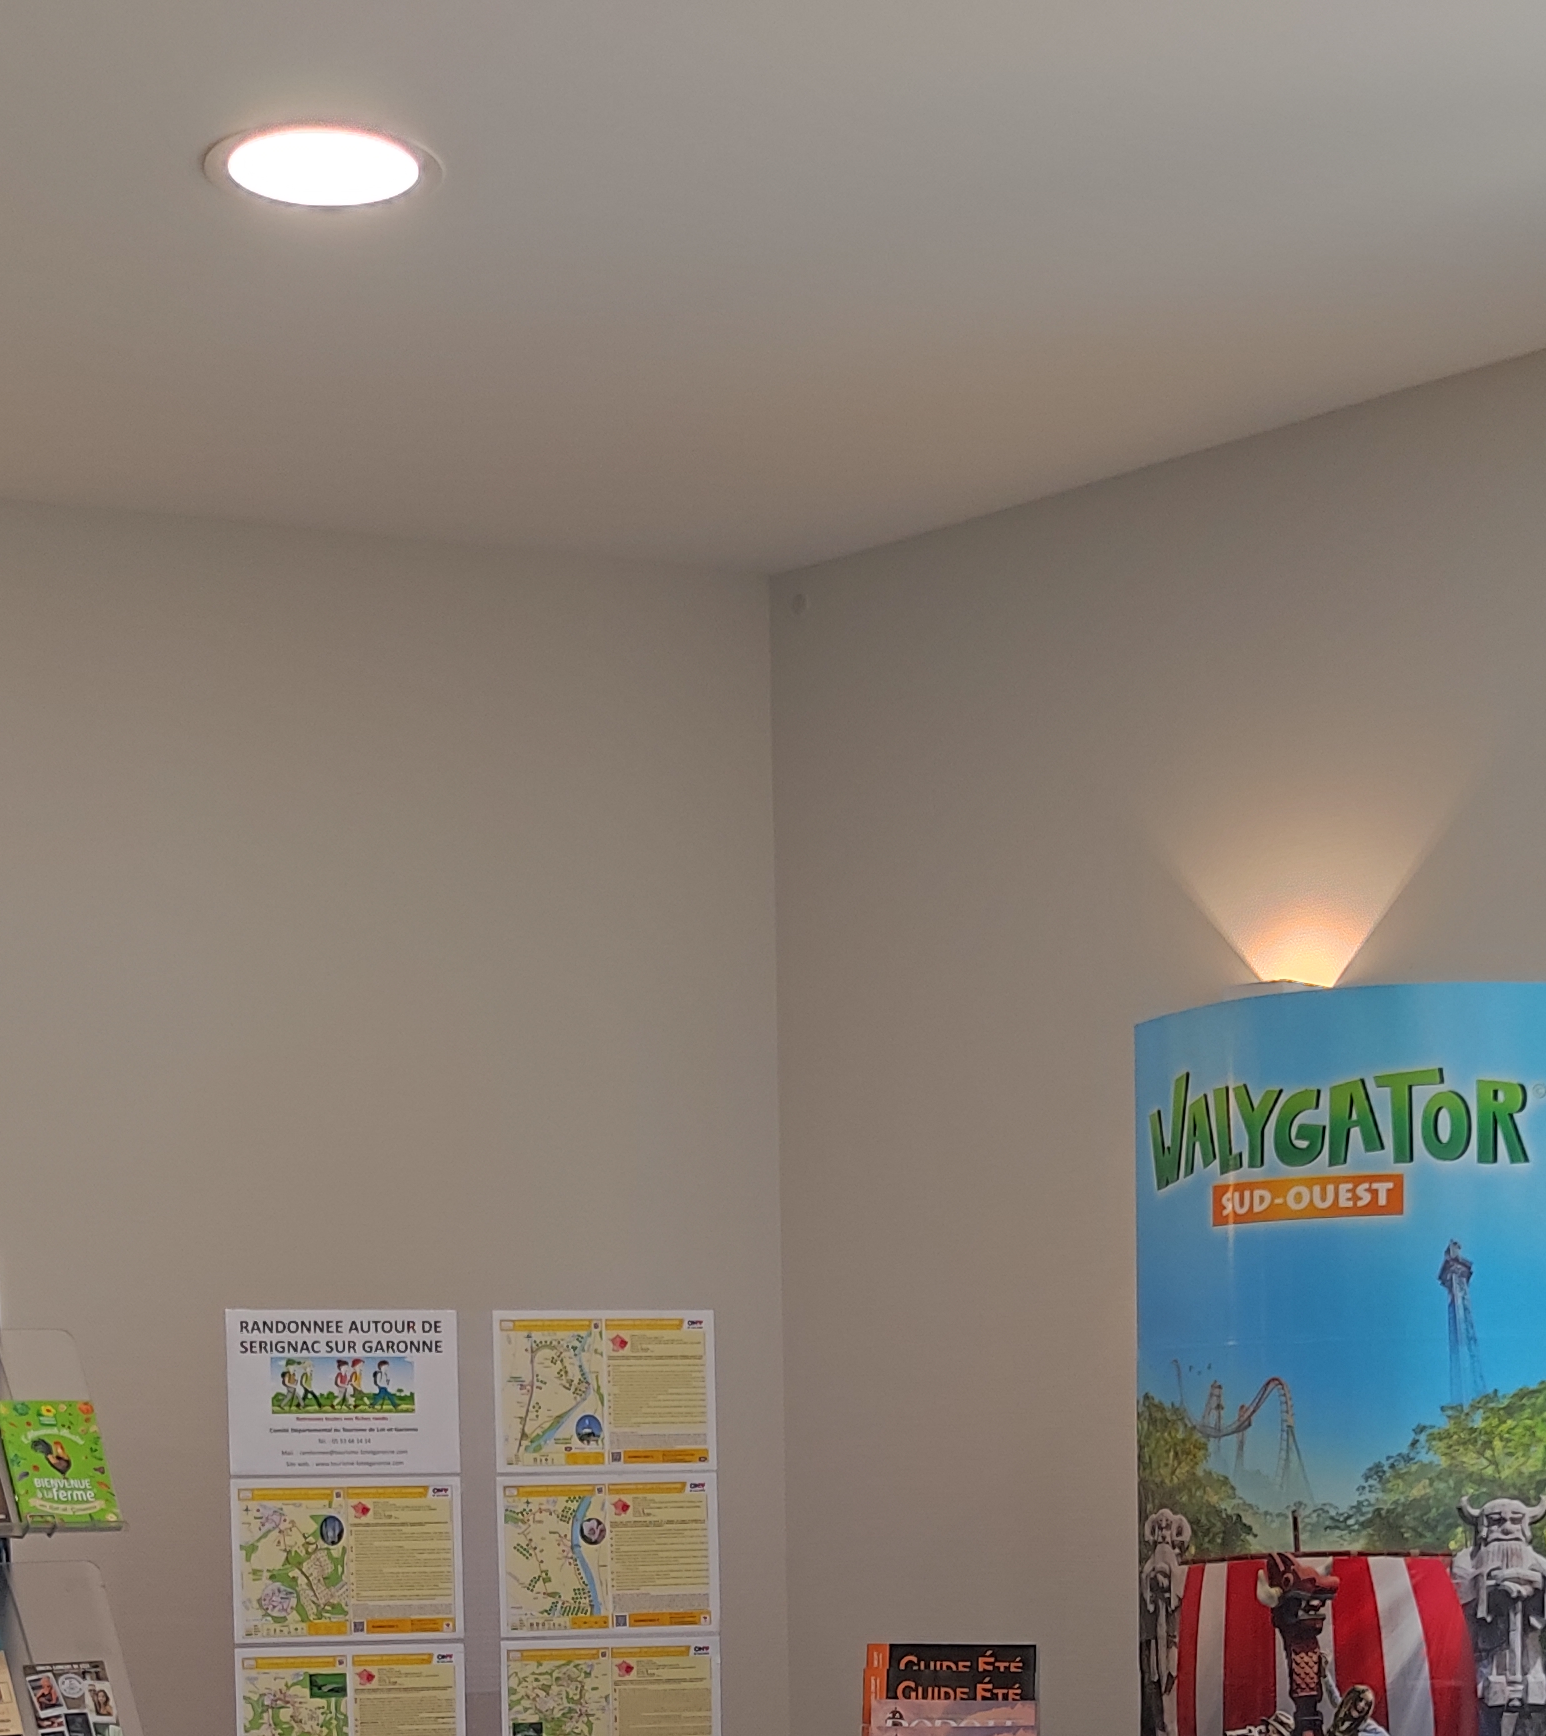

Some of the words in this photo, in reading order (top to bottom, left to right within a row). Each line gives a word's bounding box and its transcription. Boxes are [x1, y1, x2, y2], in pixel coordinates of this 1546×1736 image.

[1149, 1067, 1531, 1191] WALYGATOR
[1220, 1182, 1394, 1217] SUD-OUEST
[239, 1320, 343, 1334] RANDONNEE
[348, 1320, 416, 1334] AUTOUR
[422, 1320, 443, 1334] DE
[239, 1340, 321, 1354] SERIGNAC
[325, 1340, 357, 1354] SUR
[362, 1340, 443, 1354] GARONNE
[34, 1478, 92, 1489] BIENVENUE
[53, 1487, 95, 1501] ferme
[978, 1650, 1024, 1672] ÉTÉ
[896, 1680, 969, 1701] GUIDE
[976, 1677, 1022, 1701] ÉTÉ
